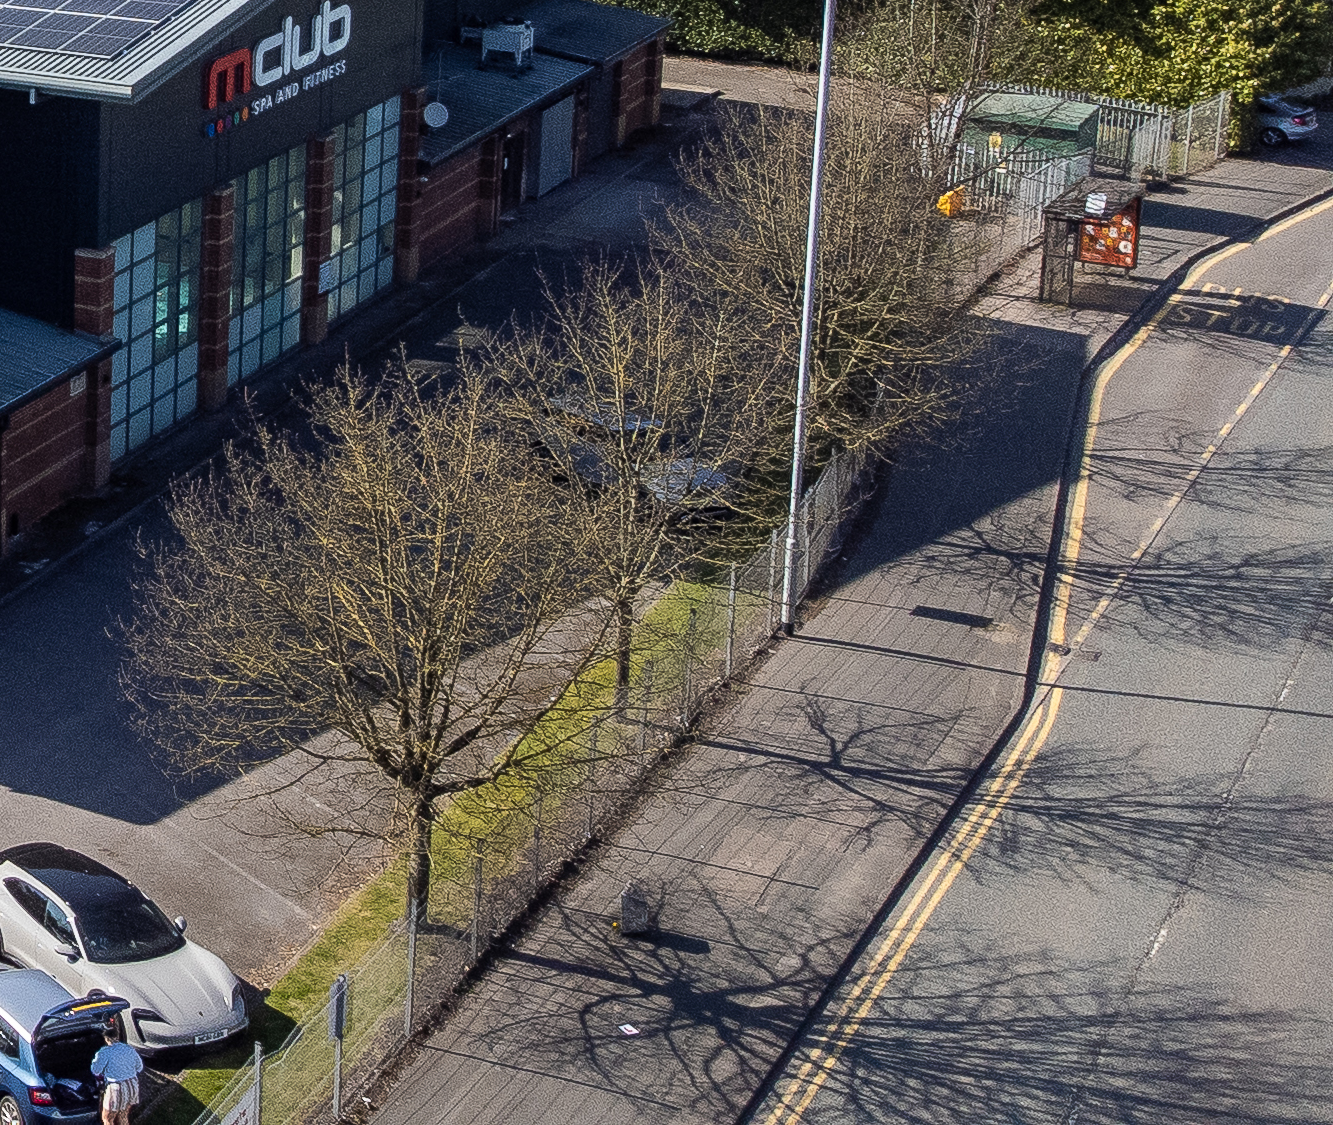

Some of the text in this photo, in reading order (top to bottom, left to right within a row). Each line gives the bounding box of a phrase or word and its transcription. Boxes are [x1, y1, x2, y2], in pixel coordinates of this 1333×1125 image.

[252, 59, 346, 115] SPA AND FITNESS
[1169, 305, 1286, 336] STOP
